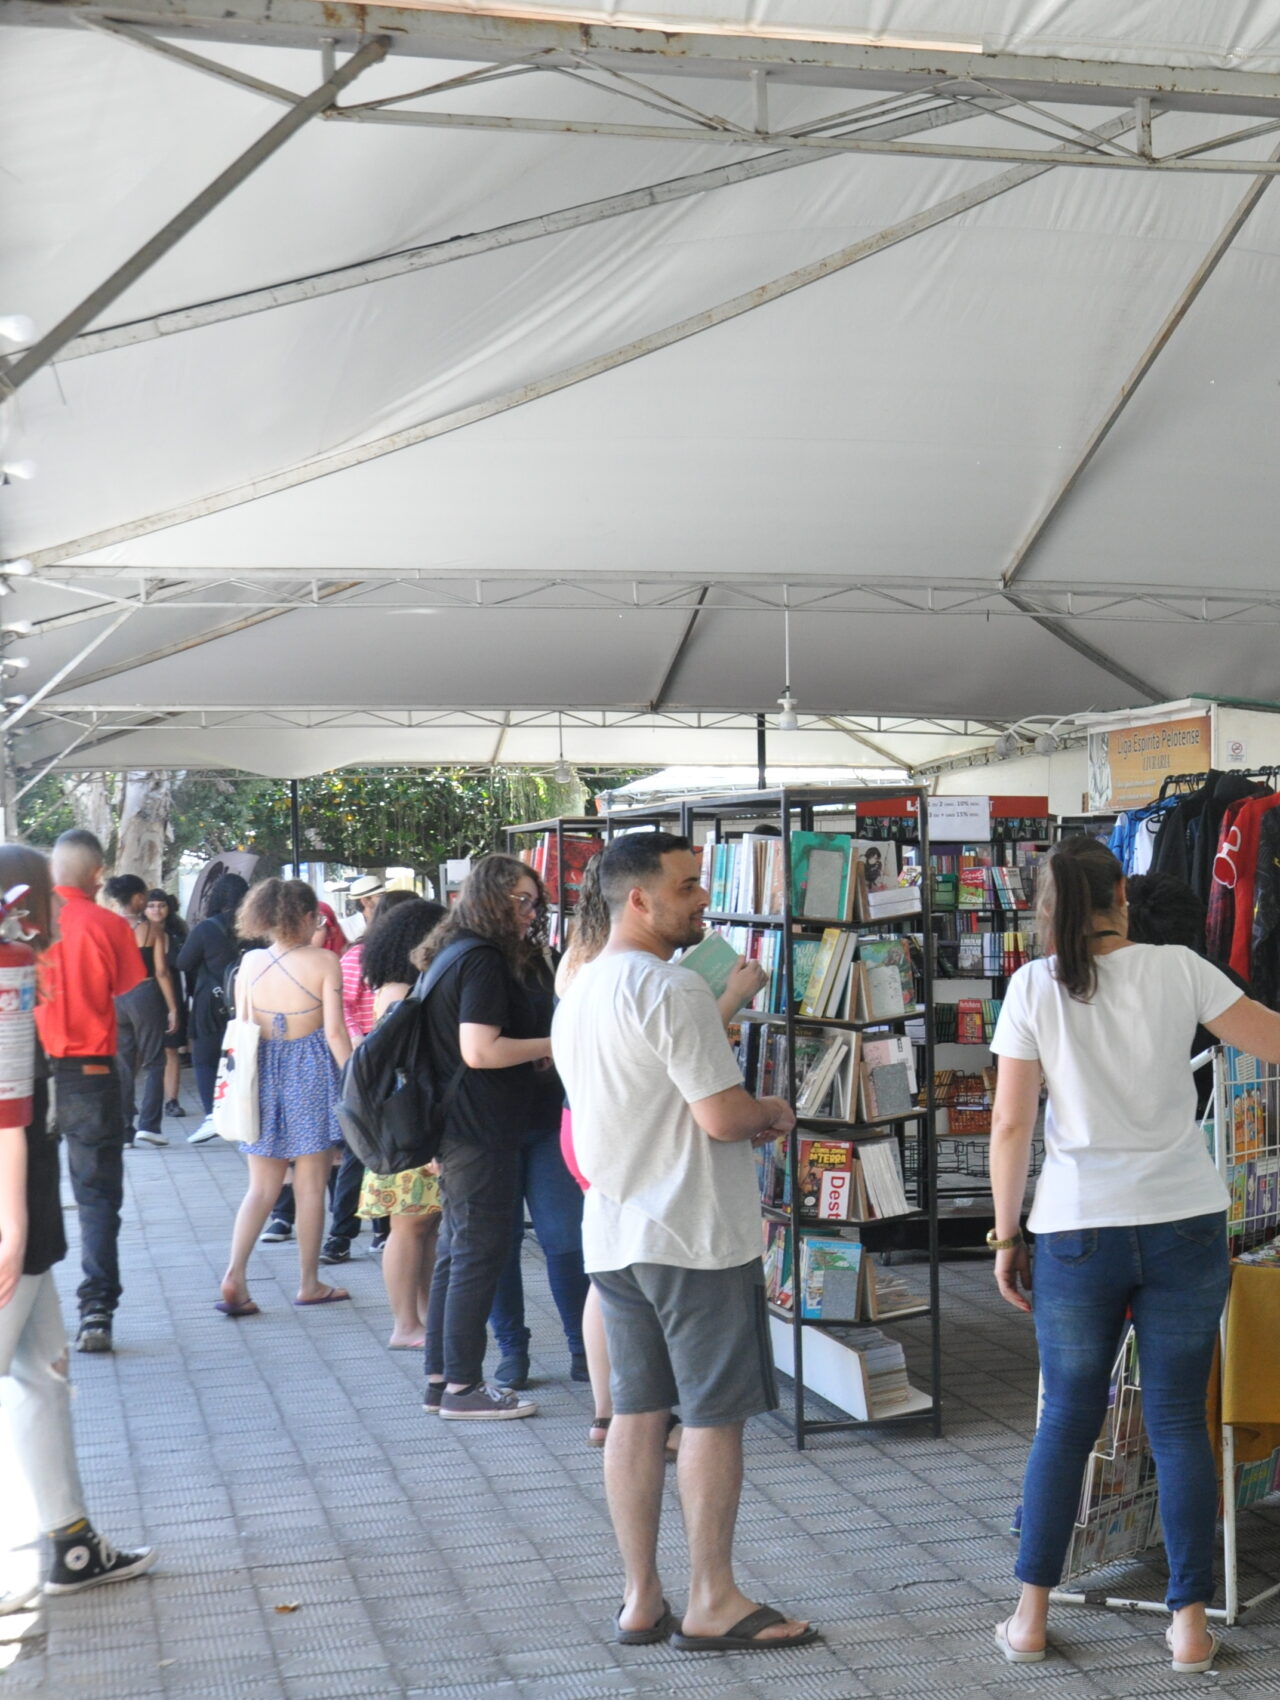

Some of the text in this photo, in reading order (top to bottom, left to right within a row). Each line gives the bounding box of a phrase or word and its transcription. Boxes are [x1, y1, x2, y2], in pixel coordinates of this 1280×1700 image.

[1117, 735, 1132, 760] Liga
[1162, 728, 1200, 748] Pelotense
[818, 1153, 846, 1164] TERRA
